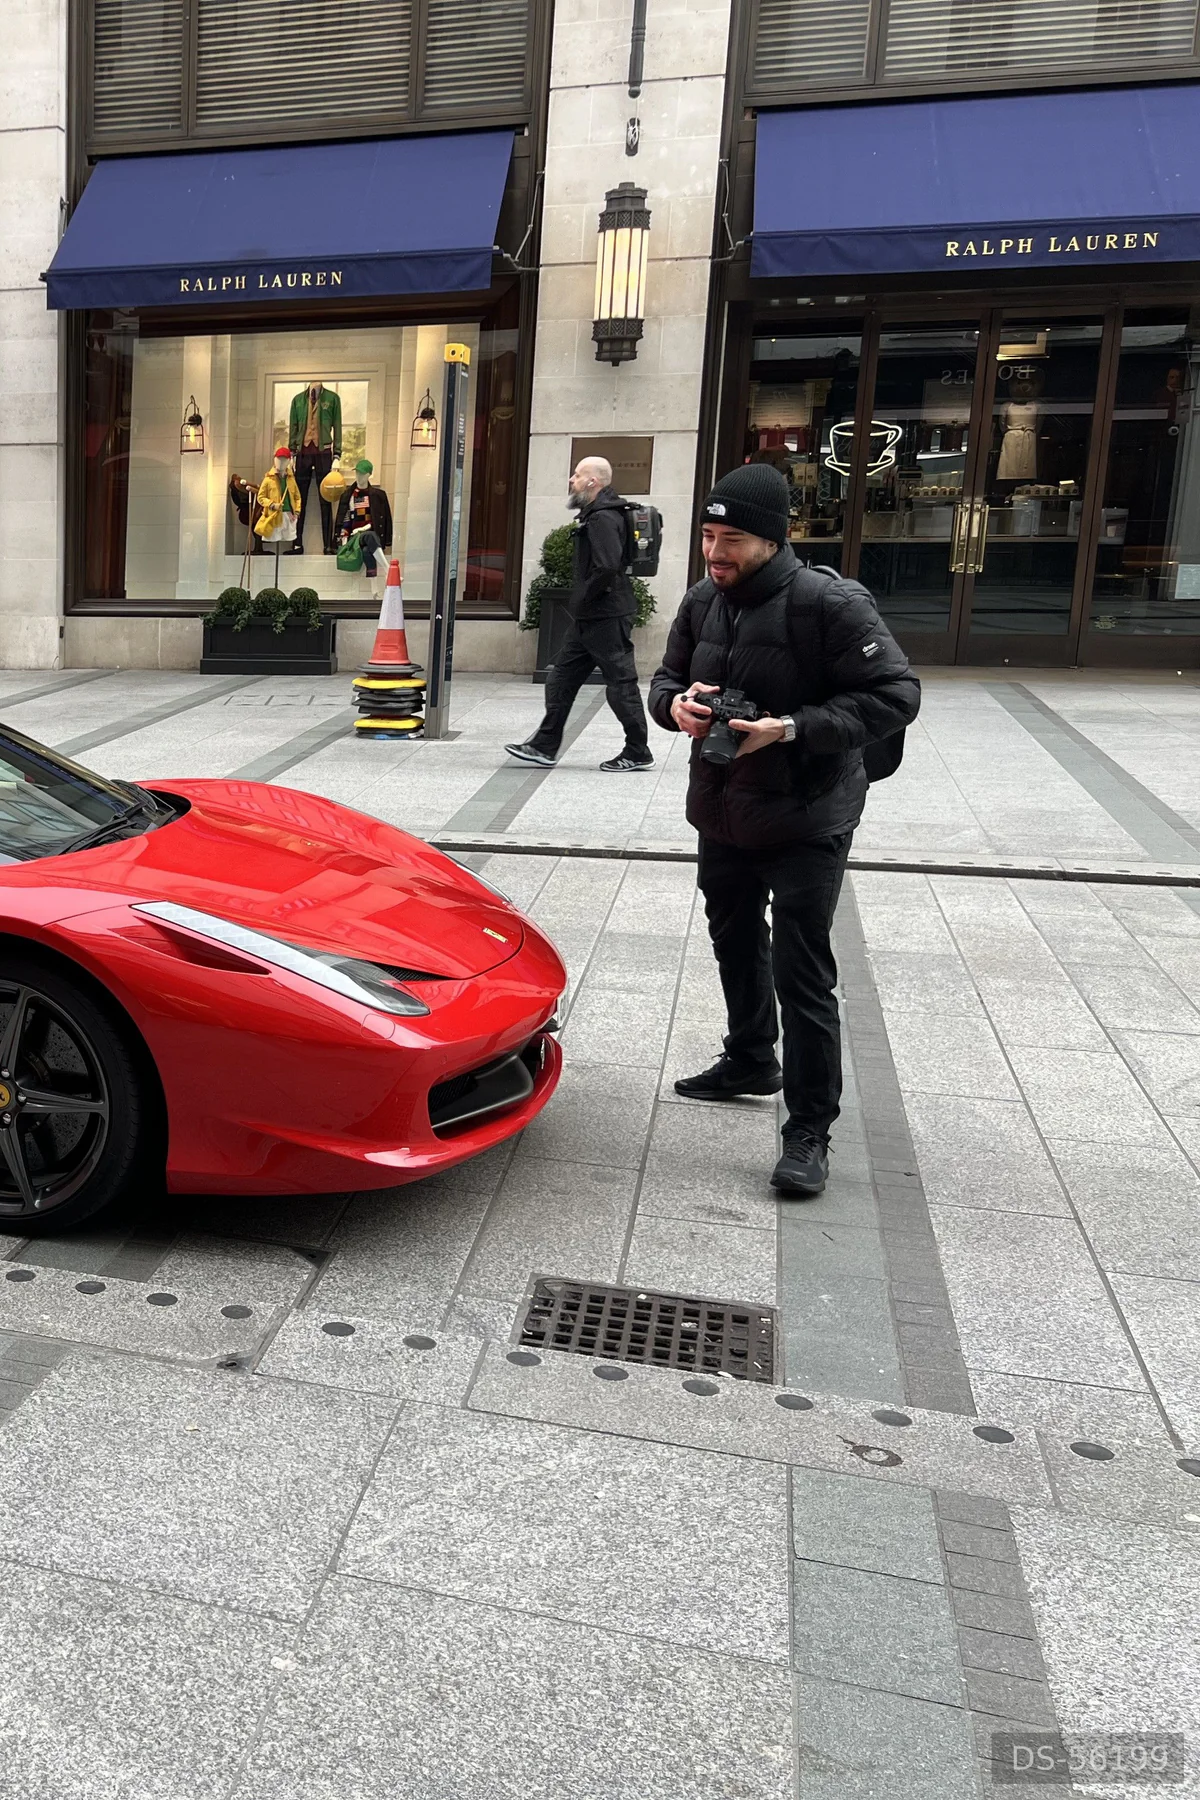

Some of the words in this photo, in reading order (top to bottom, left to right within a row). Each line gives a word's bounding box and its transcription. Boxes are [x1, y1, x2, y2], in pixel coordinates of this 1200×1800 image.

[945, 238, 1033, 256] RALPH
[1049, 232, 1159, 252] LAUREN
[180, 276, 247, 292] RALPH
[258, 271, 343, 288] LAUREN
